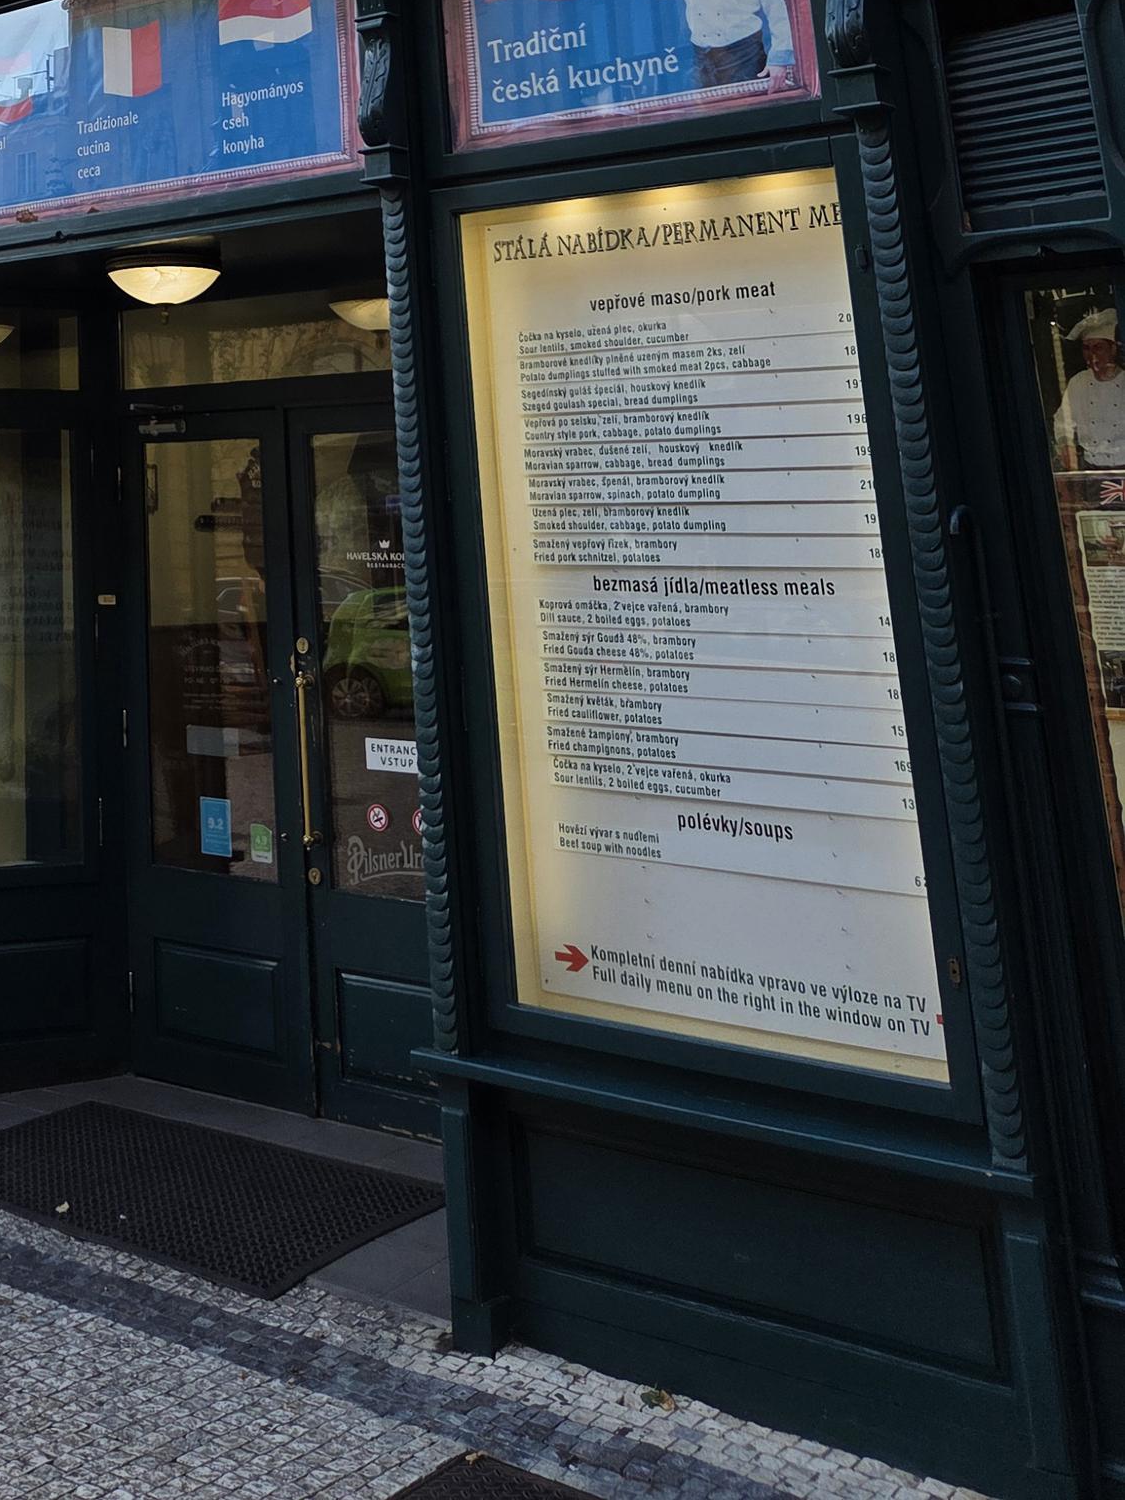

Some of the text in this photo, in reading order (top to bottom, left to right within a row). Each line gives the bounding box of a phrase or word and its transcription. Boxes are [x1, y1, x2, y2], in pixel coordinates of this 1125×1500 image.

[487, 22, 587, 63] Tradiční
[492, 47, 679, 103] česká kuchyně
[221, 79, 304, 108] Hagyományos
[77, 112, 139, 135] Tradizionale
[222, 112, 250, 131] cseh
[77, 139, 110, 157] cucina
[222, 134, 265, 156] konyha
[77, 164, 101, 180] ceca
[493, 234, 553, 264] STÁLÁ
[557, 207, 801, 257] NABÍDKA/PERMANENT
[590, 281, 776, 314] vepřové maso/pork meat
[593, 576, 835, 597] bezmasá jídla/meatless meals
[544, 675, 688, 693] Fried Hermelín cheese, potatoes
[380, 756, 414, 768] VSTUP
[677, 812, 794, 843] polévky/soups
[347, 835, 402, 886] Pilsner
[559, 836, 661, 859] Beef soup with noodles
[590, 944, 926, 1013] Kompletní denní nabídka vpravo ve výloze na TV
[592, 965, 930, 1036] Full daily menu on the right in the window on TV
